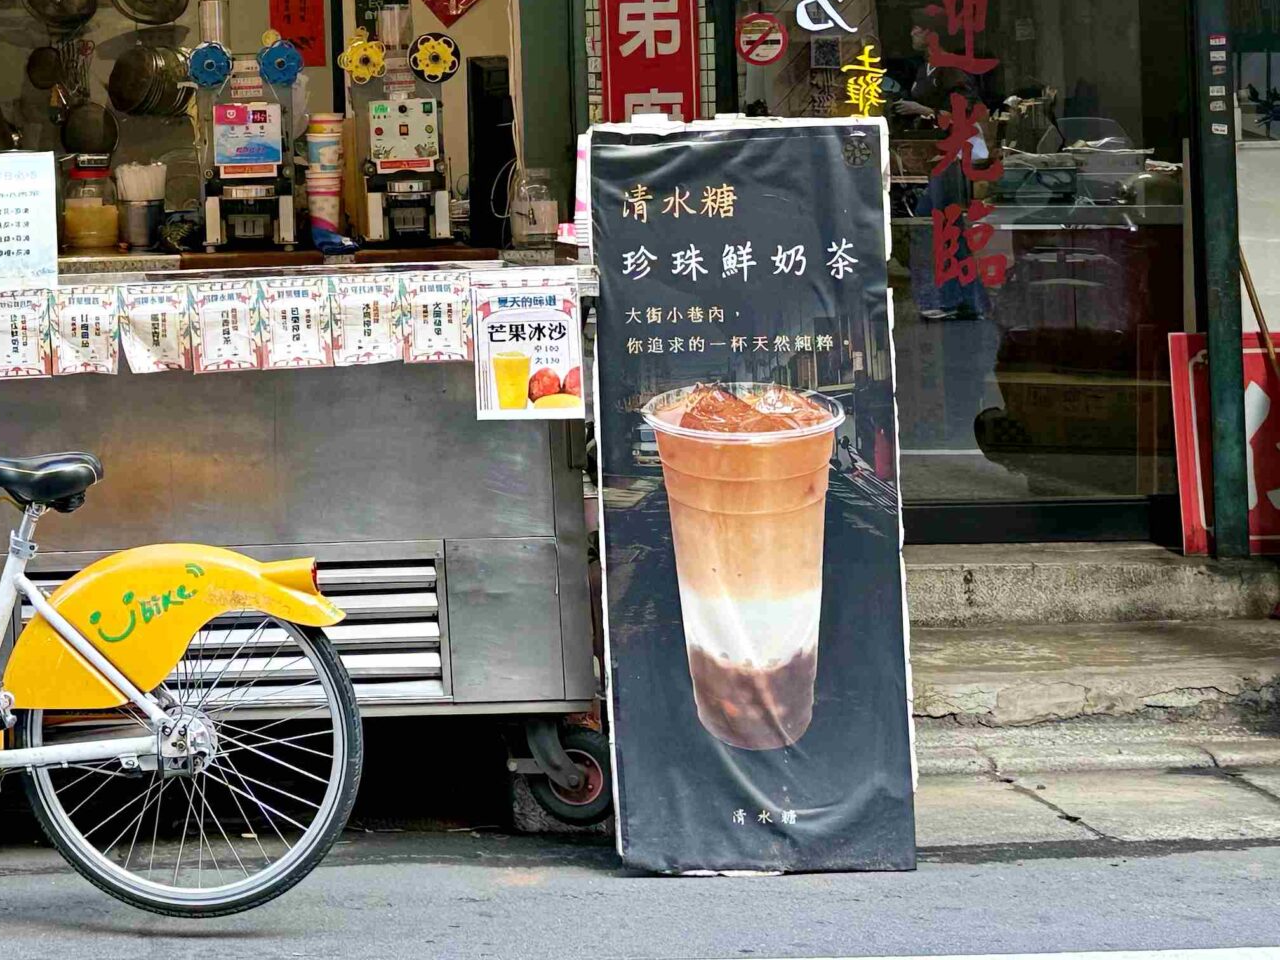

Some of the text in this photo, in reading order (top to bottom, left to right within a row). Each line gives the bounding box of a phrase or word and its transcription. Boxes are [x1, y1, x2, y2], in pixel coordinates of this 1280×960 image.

[622, 183, 738, 224] 清水糖
[622, 238, 859, 283] 珍珠鮮奶茶
[487, 322, 568, 343] 芒果冰沙
[731, 808, 798, 826] 清水糖
